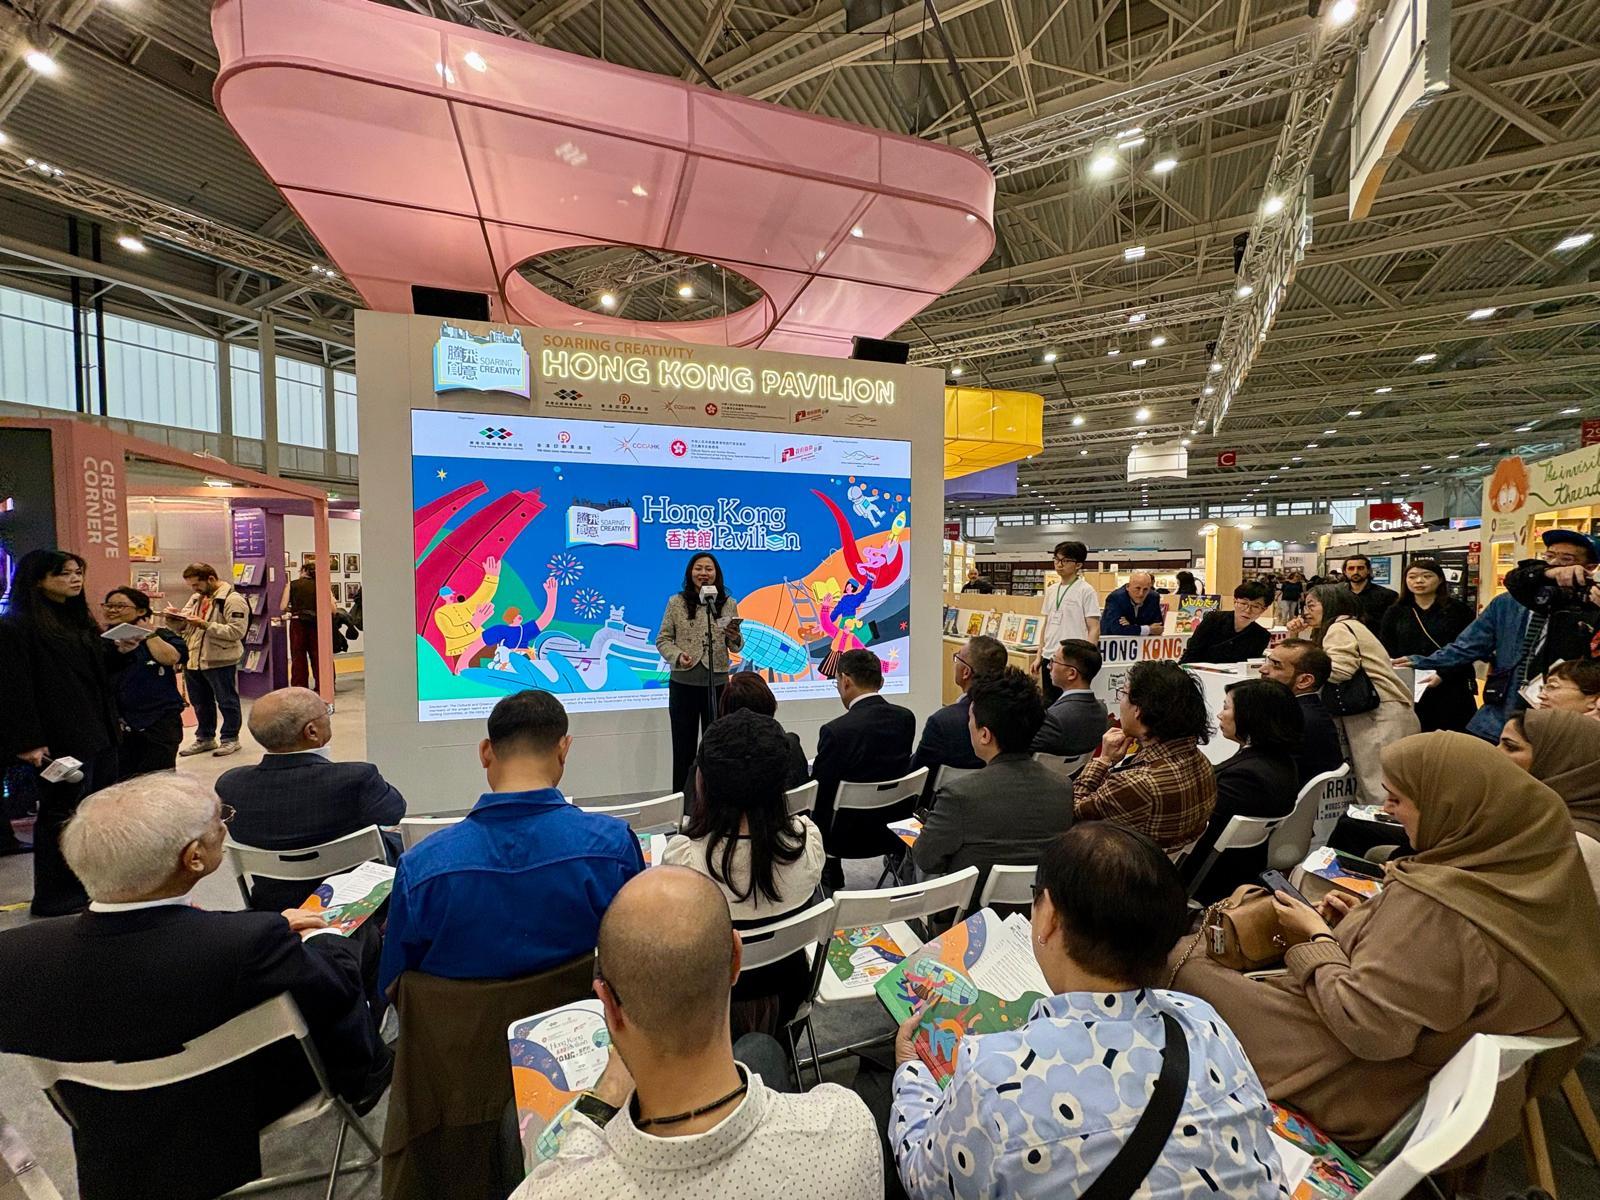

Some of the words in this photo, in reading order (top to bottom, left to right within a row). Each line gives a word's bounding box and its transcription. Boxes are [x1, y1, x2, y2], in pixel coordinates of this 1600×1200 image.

[543, 335, 611, 351] SOARING
[614, 340, 694, 359] CREATIVITY
[480, 357, 513, 367] SOARING
[480, 366, 521, 376] CREATIVITY
[542, 350, 650, 385] HONG
[659, 360, 754, 394] KONG
[762, 369, 895, 404] PAVILION
[1221, 454, 1234, 465] C
[83, 456, 102, 544] CORNER
[100, 460, 119, 558] CREATIVE
[642, 495, 714, 526] Hong
[718, 498, 786, 530] Kong
[666, 530, 713, 549] 香港館
[1098, 640, 1138, 661] HONG
[1142, 638, 1182, 660] KONG
